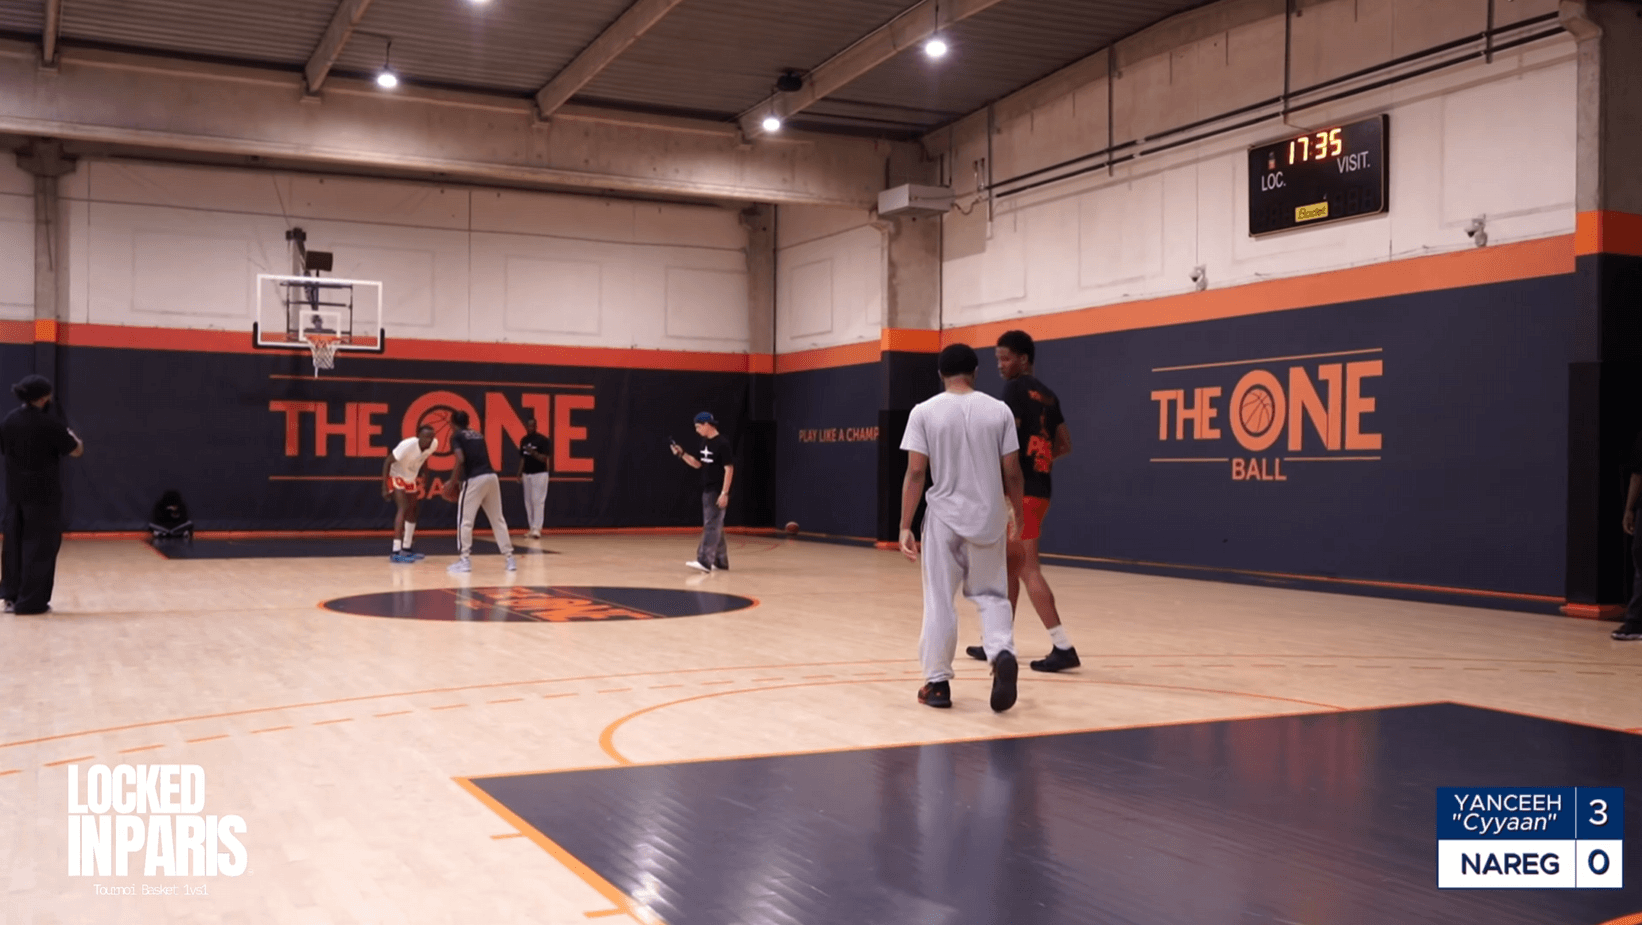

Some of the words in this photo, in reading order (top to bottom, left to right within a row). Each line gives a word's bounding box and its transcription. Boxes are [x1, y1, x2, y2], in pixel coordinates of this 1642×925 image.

[1337, 151, 1371, 174] VISIT.
[1261, 171, 1286, 191] LOC.
[1151, 387, 1222, 440] THE
[1229, 360, 1383, 451] ONE
[269, 400, 389, 457] THE
[402, 390, 595, 472] ONE
[799, 428, 817, 442] PLAY
[819, 427, 836, 442] LIKE
[839, 428, 844, 441] A
[1232, 458, 1287, 481] BALL
